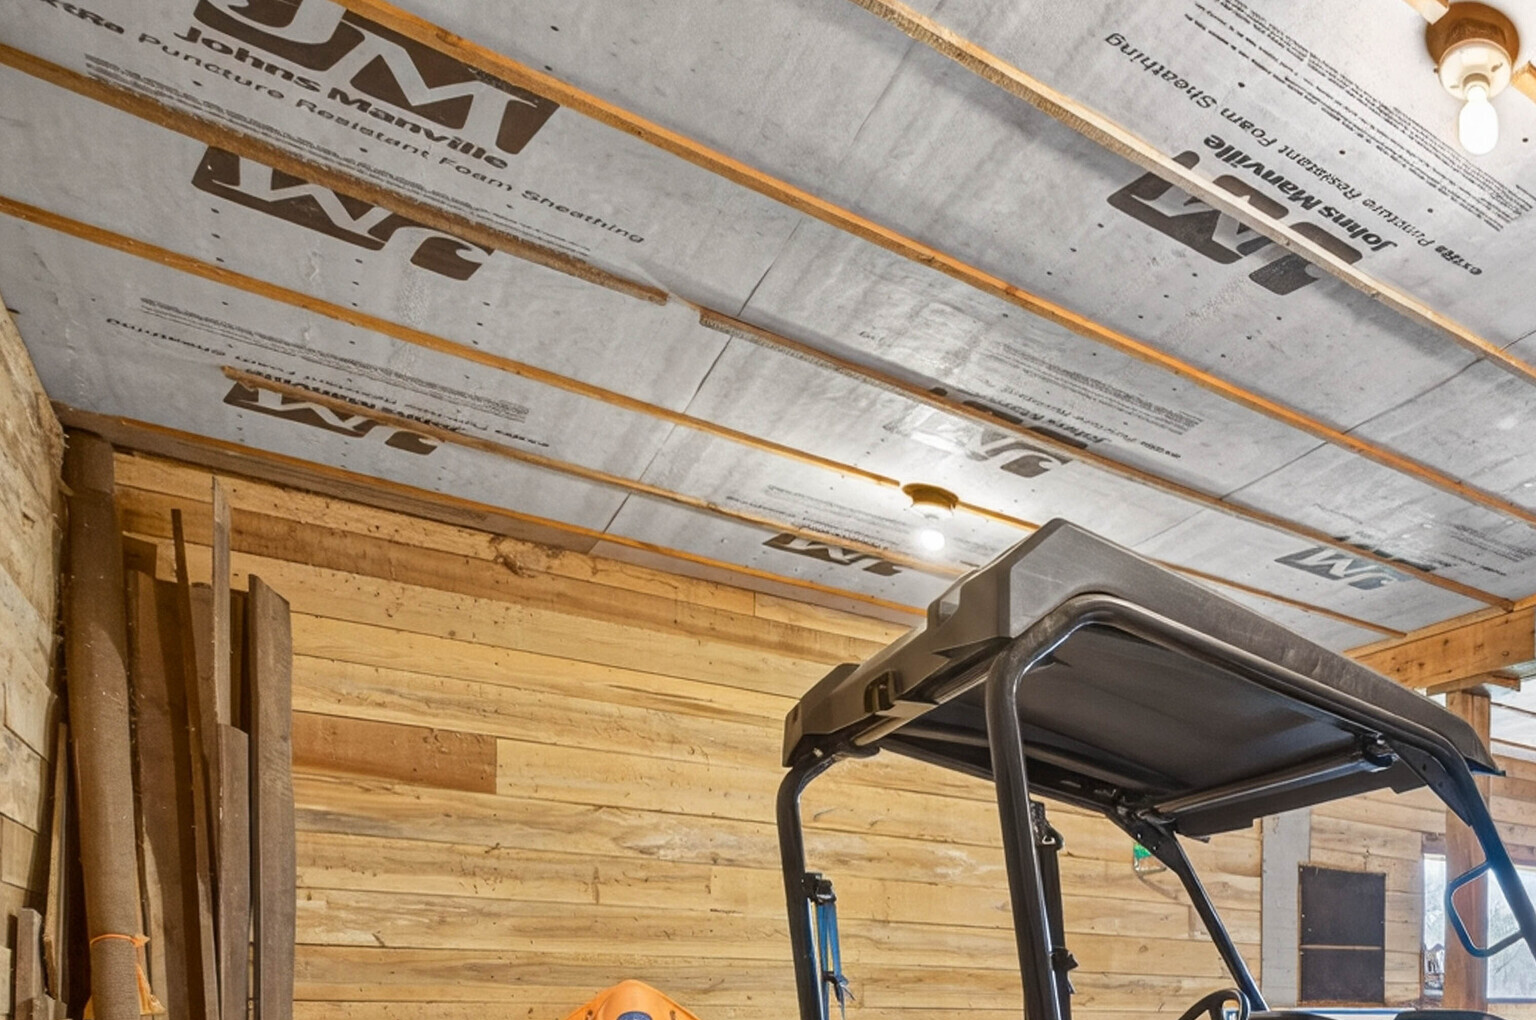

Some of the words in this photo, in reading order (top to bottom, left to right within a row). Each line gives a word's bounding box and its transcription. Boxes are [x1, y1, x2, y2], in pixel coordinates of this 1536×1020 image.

[173, 26, 320, 92] Johns
[327, 88, 510, 169] Manville
[1104, 33, 1217, 108] Sheathing
[138, 33, 284, 99] Puncture
[296, 99, 429, 159] Resistant
[439, 157, 512, 191] Foam
[522, 190, 644, 243] Sheathing
[1220, 108, 1277, 147] Foam
[1204, 134, 1323, 210] Manville
[1278, 145, 1362, 200] Resistant
[1318, 206, 1398, 252] Johns
